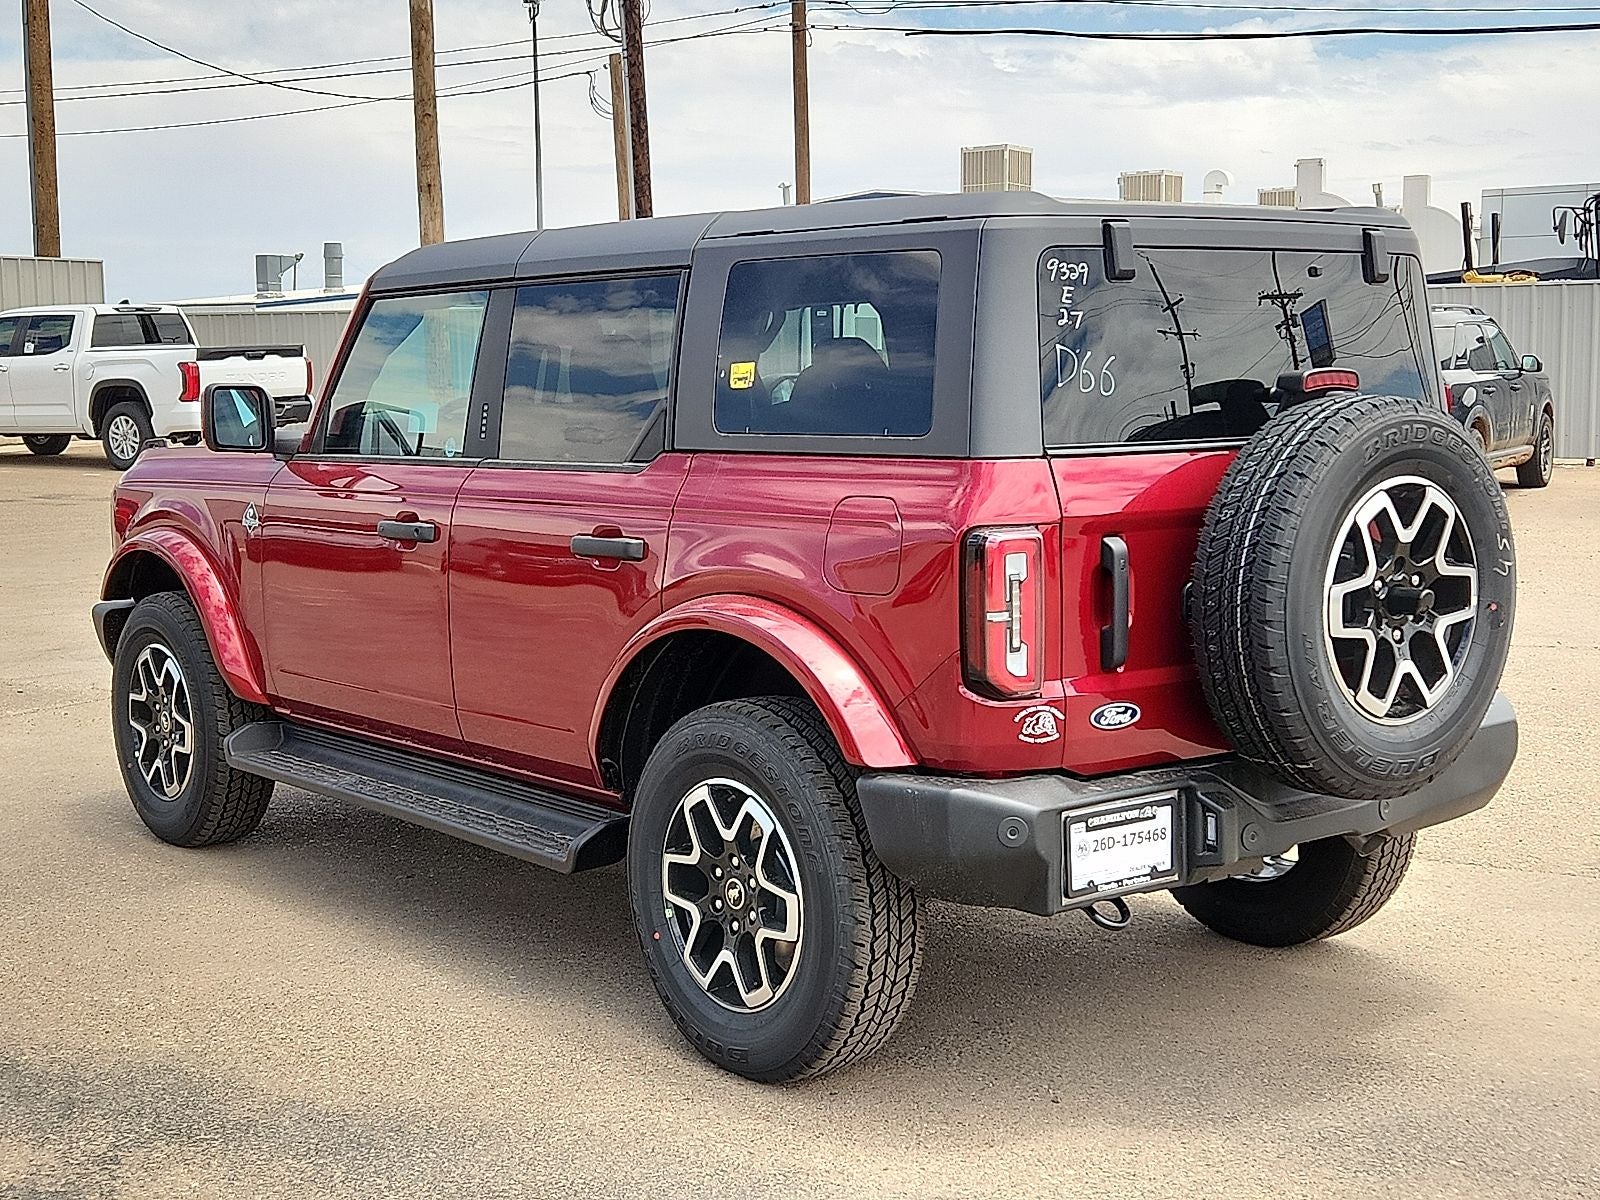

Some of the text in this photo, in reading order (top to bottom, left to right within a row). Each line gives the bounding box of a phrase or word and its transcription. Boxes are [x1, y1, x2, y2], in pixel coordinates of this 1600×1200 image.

[1046, 258, 1089, 286] 9329
[1061, 286, 1075, 304] E
[1099, 706, 1133, 726] Ford
[1316, 700, 1441, 776] DUELER
[674, 731, 821, 873] BRIDGESTONE
[1092, 827, 1167, 853] 26D-175468
